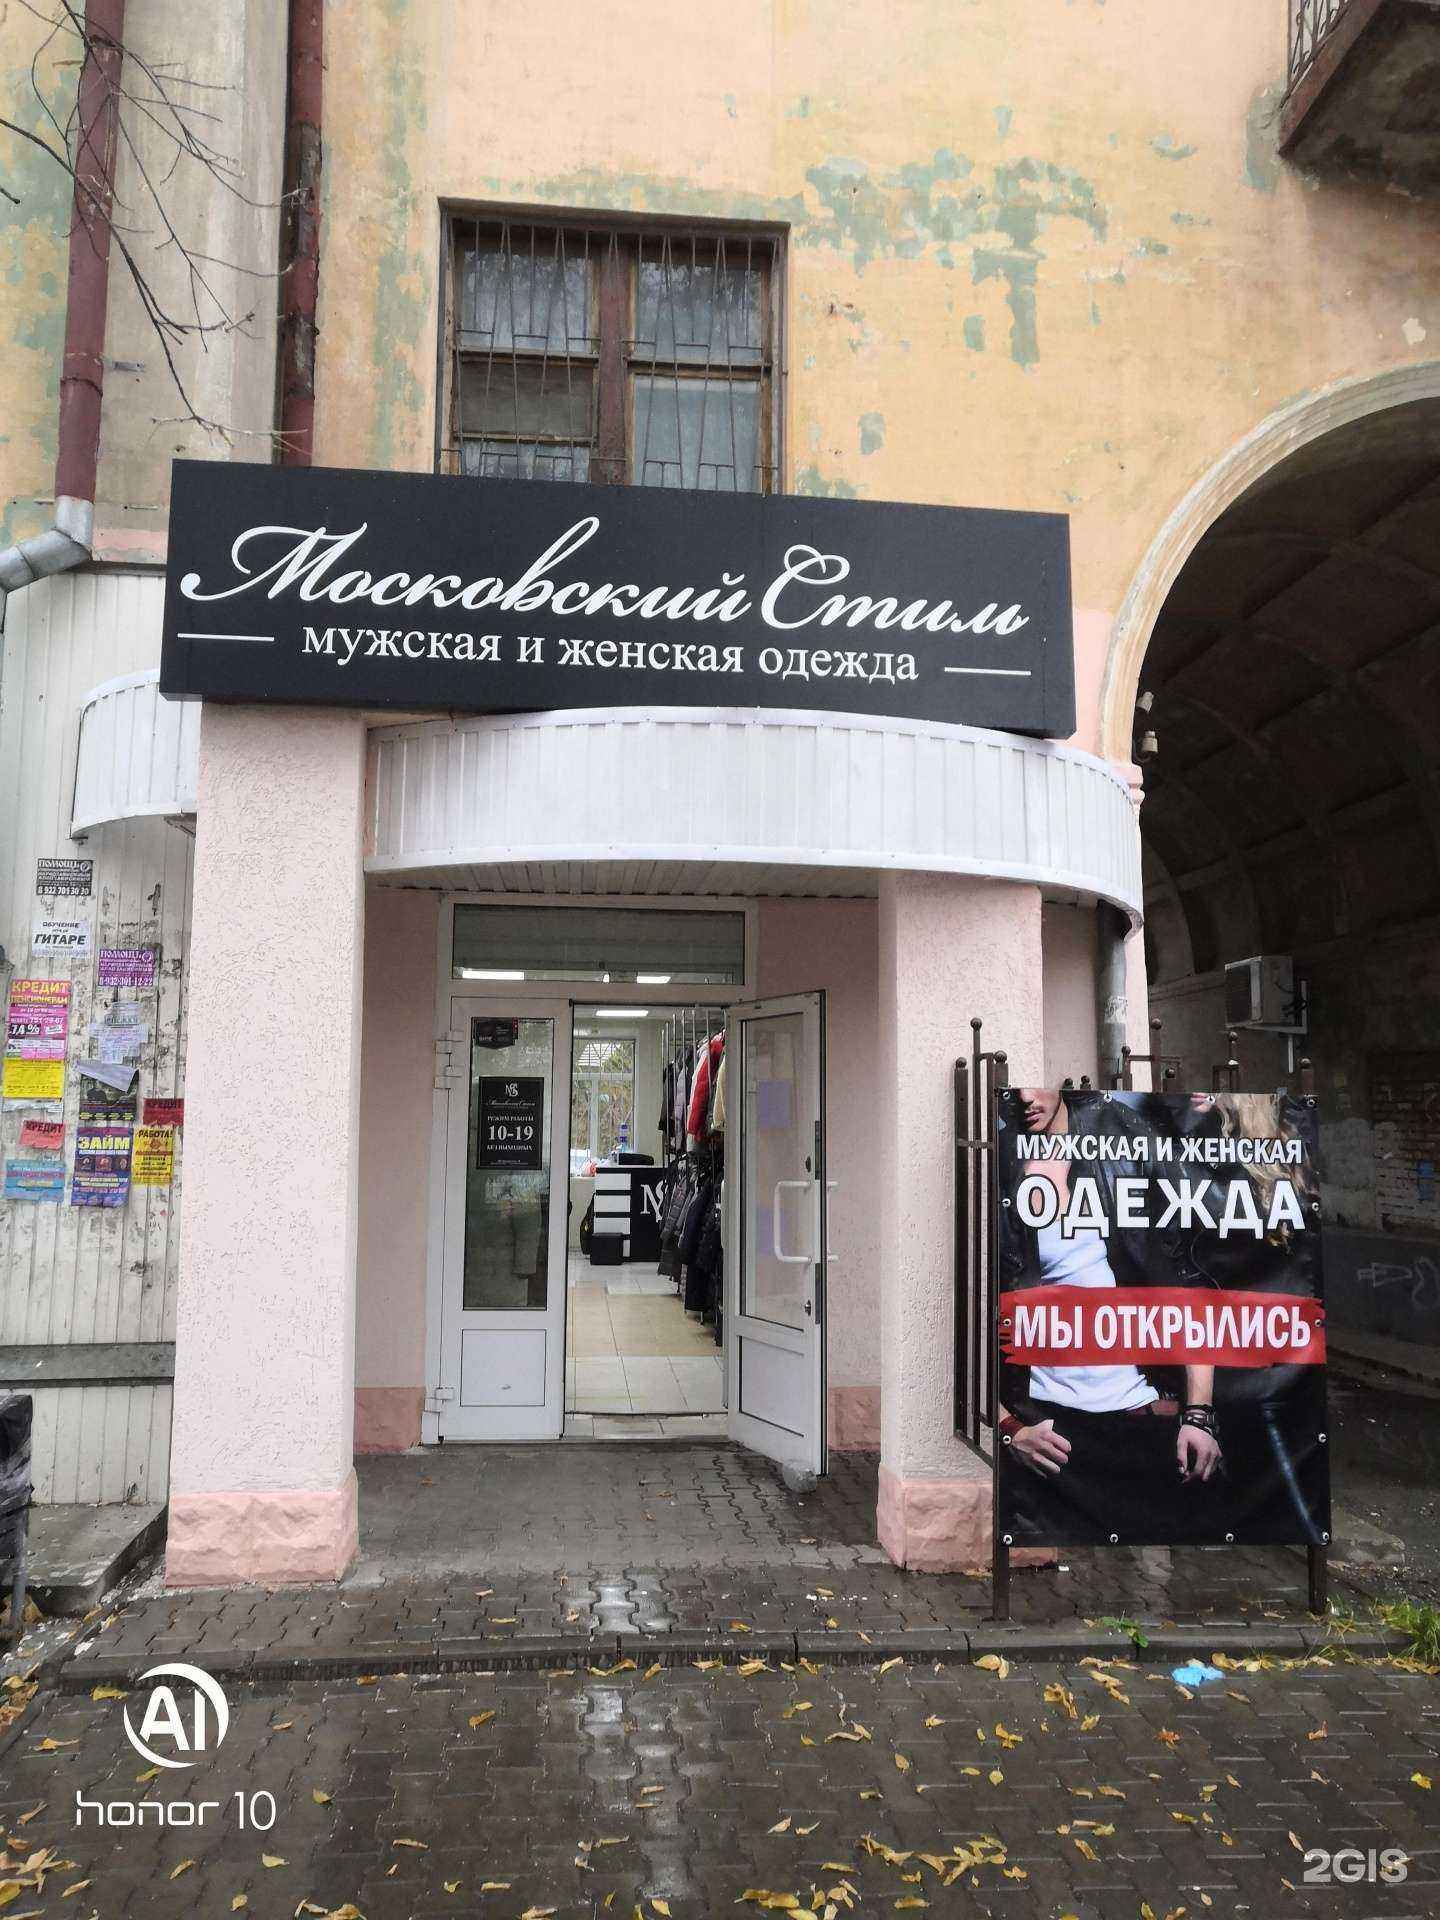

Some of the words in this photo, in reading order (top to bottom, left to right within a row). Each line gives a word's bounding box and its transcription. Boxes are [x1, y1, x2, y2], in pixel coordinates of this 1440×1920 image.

[180, 516, 752, 622] Московский
[761, 544, 1030, 635] Стиль
[301, 626, 502, 665] мужская
[516, 636, 545, 663] и
[558, 638, 744, 673] женская
[758, 646, 920, 685] одежда
[34, 933, 87, 945] ГИТАРЕ
[12, 980, 71, 995] КРЕДИТ
[25, 1120, 64, 1134] КРЕДИТ
[488, 1125, 534, 1141] 10-19
[78, 1134, 130, 1150] ЗАЙМ
[1016, 1134, 1150, 1161] МУЖСКАЯ
[1156, 1136, 1174, 1161] И
[1179, 1137, 1302, 1164] ЖЕНСКАЯ
[1016, 1176, 1306, 1239] ОДЕЖДА
[1014, 1305, 1083, 1349] МЫ
[1094, 1304, 1311, 1349] ОТКРЫЛИСЬ
